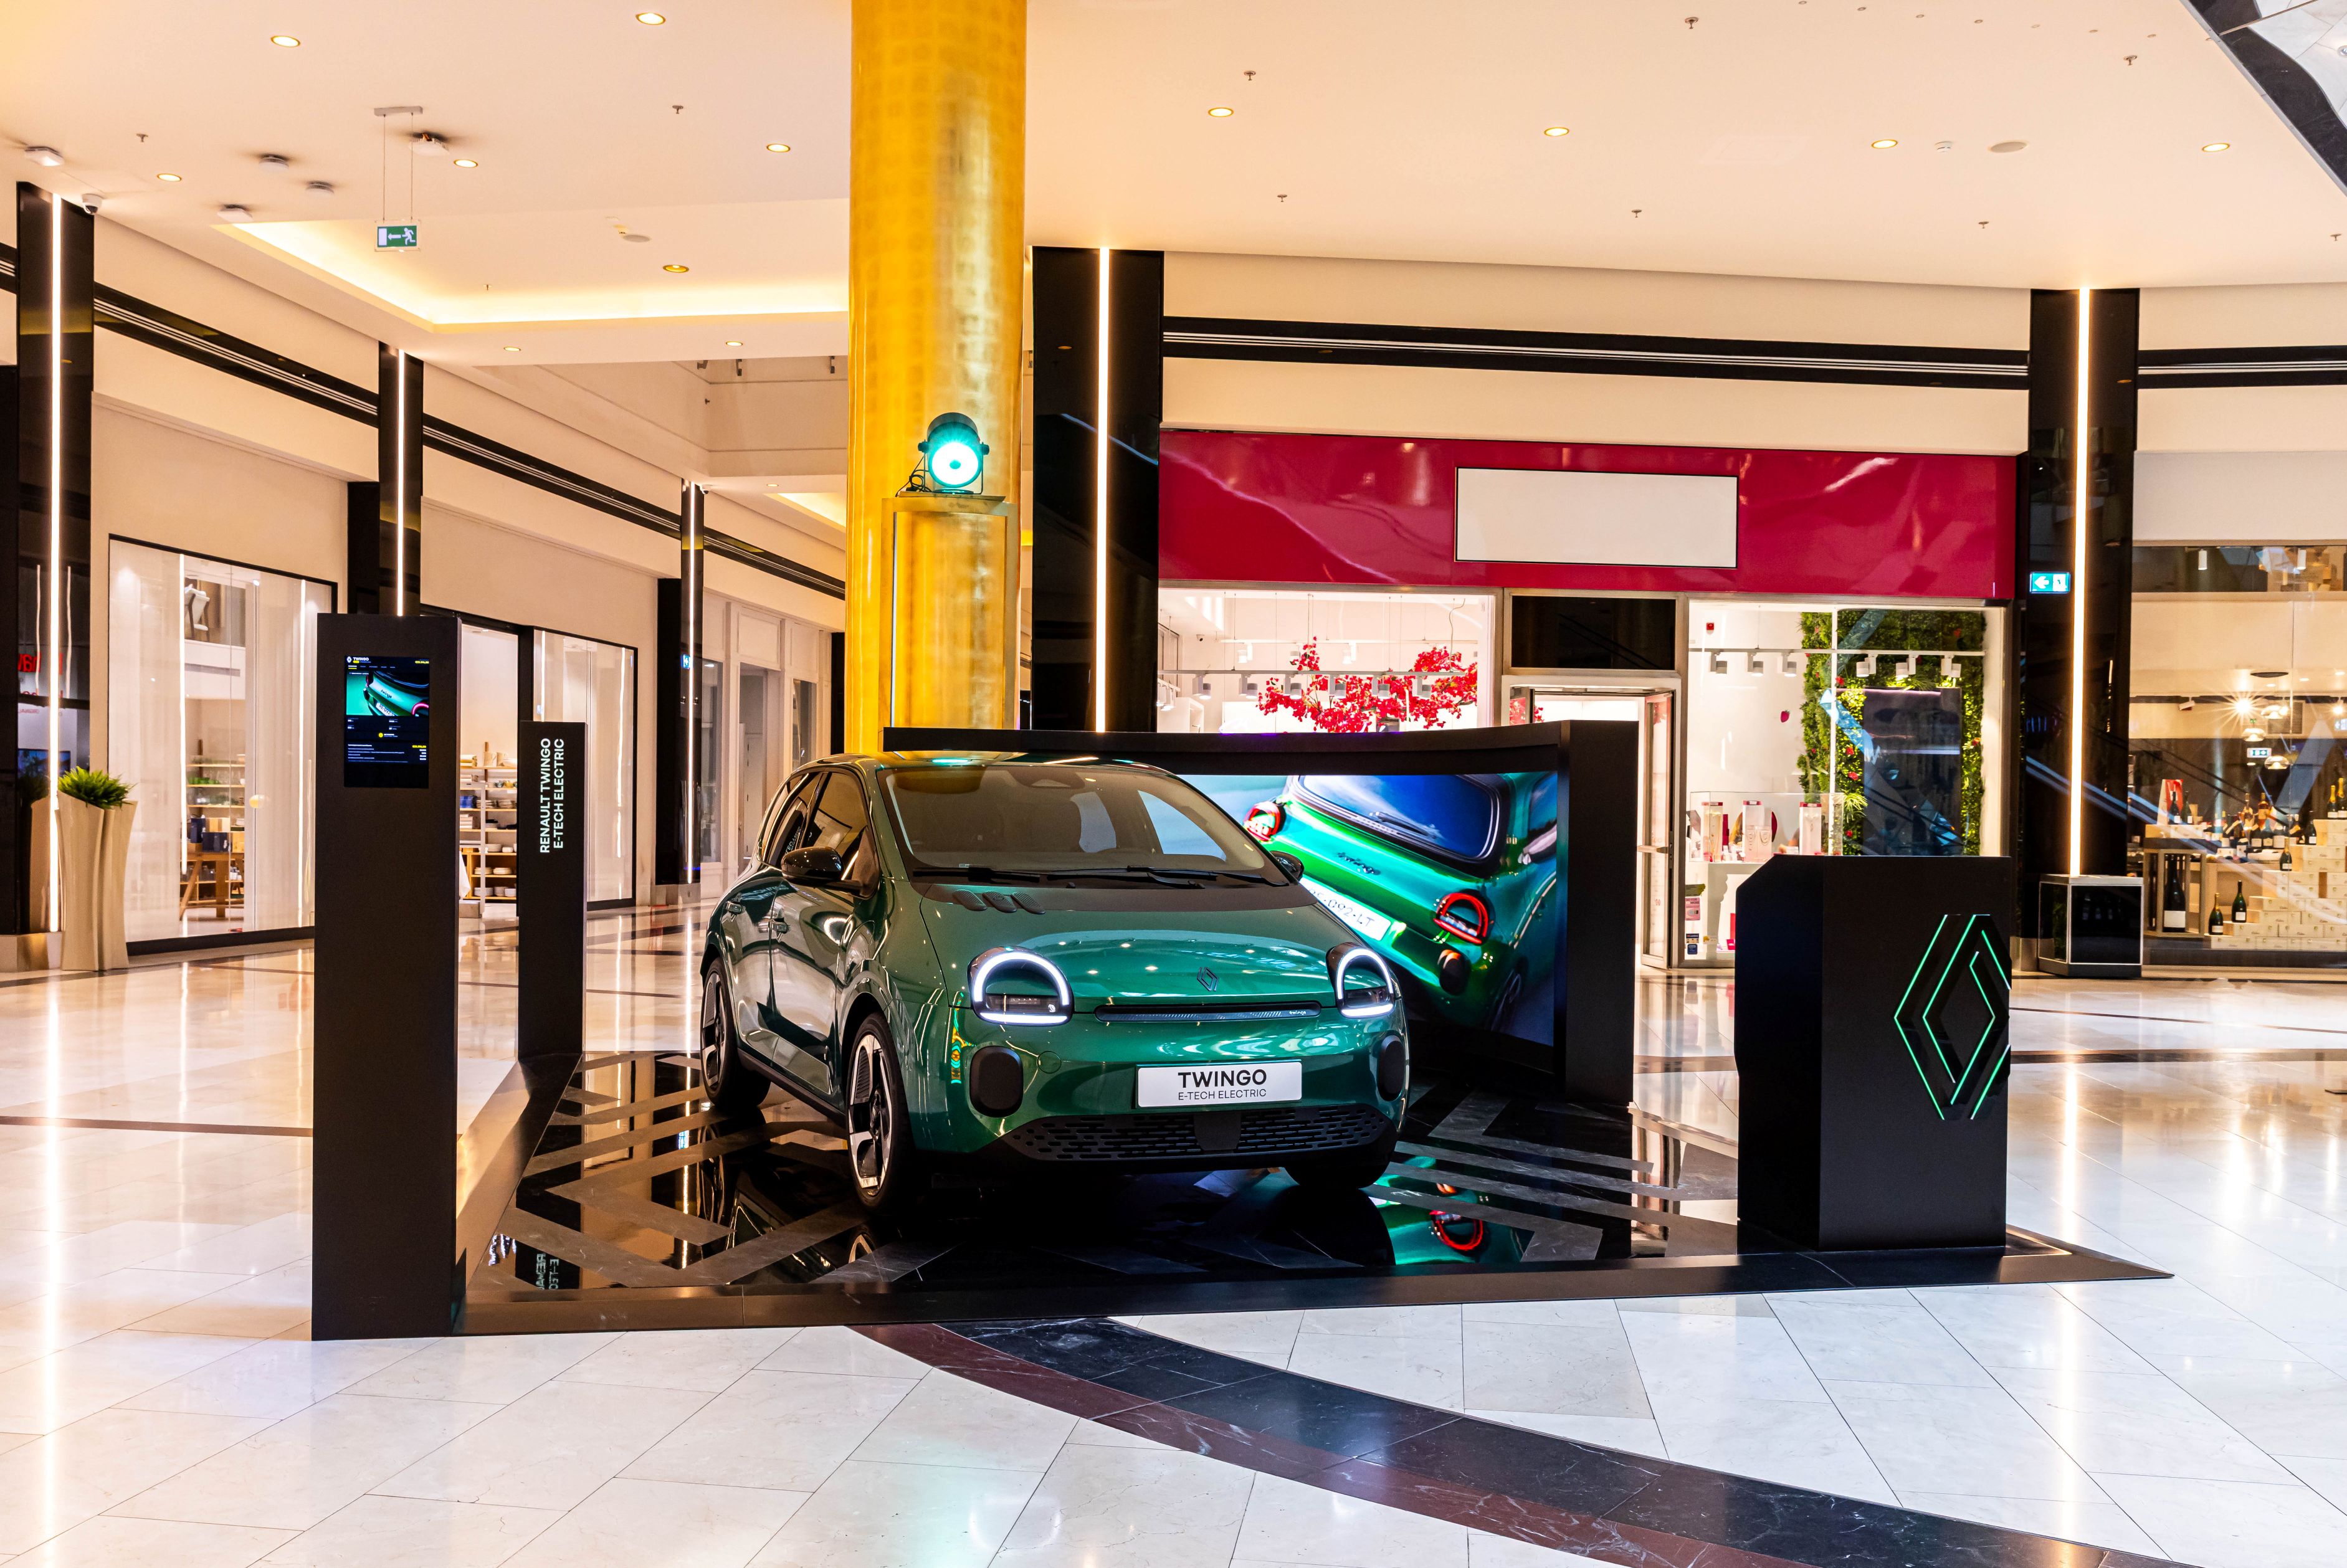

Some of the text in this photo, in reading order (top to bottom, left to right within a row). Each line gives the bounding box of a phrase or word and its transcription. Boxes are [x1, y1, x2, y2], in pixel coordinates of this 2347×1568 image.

[540, 738, 551, 853] RENAULT TWINGO
[553, 738, 564, 848] E-TECH ELECTRIC
[1178, 1069, 1267, 1088] TWINGO
[1178, 1088, 1267, 1101] E-TECH ELECTRIC
